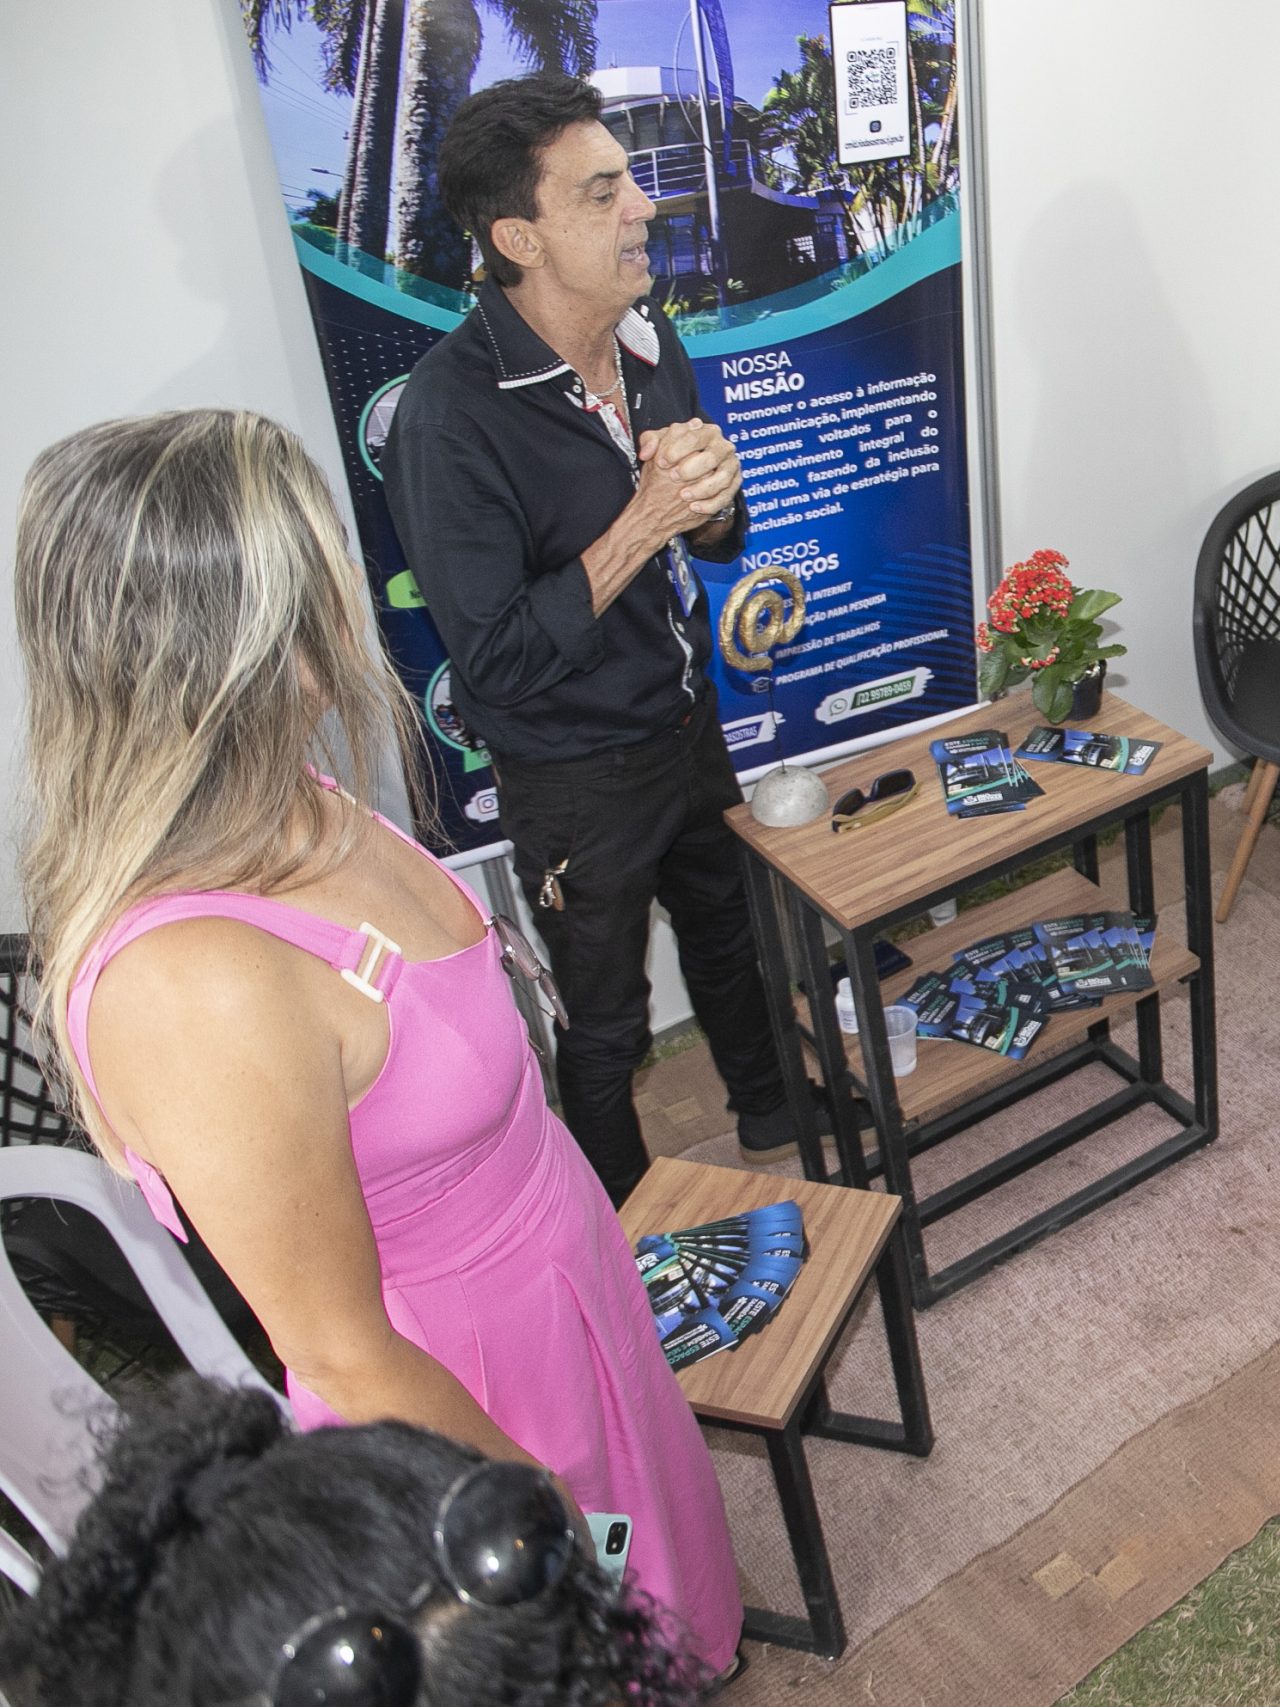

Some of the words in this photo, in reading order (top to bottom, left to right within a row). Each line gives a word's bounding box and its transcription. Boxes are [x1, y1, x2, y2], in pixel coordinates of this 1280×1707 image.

[721, 350, 793, 379] NOSSA
[724, 371, 805, 403] MISSÃO
[727, 401, 793, 424] Promover
[796, 400, 806, 410] o
[809, 391, 853, 408] acesso
[855, 386, 865, 398] à
[867, 372, 936, 396] informação
[729, 433, 739, 443] e
[740, 429, 749, 441] à
[751, 412, 840, 438] comunicação,
[841, 390, 937, 421] implementando
[818, 423, 872, 444] voltados
[885, 414, 912, 430] para
[927, 409, 938, 419] o
[742, 449, 844, 479] esenvolvimento
[858, 431, 905, 453] integral
[920, 426, 939, 438] do
[807, 463, 858, 483] fazendo
[864, 456, 881, 469] da
[887, 443, 939, 463] inclusão
[747, 498, 779, 517] igital
[781, 493, 811, 507] uma
[811, 486, 831, 500] via
[832, 482, 850, 496] de
[850, 466, 910, 491] estratégia
[911, 462, 940, 478] para
[749, 512, 804, 533] inclusão
[804, 502, 845, 521] social.
[742, 538, 820, 573] NOSSOS
[812, 581, 854, 600] INTERNET
[826, 605, 849, 619] PARA
[849, 593, 887, 612] PESQUISA
[775, 638, 823, 659] IMPRESSÃO
[823, 635, 836, 647] DE
[836, 620, 881, 642] TRABALHOS
[775, 665, 824, 686] PROGRAMA
[824, 661, 836, 672] DE
[836, 642, 893, 669] QUALIFICAÇÃO
[893, 628, 950, 651] PROFISSIONAL
[700, 1333, 720, 1348] ESTE
